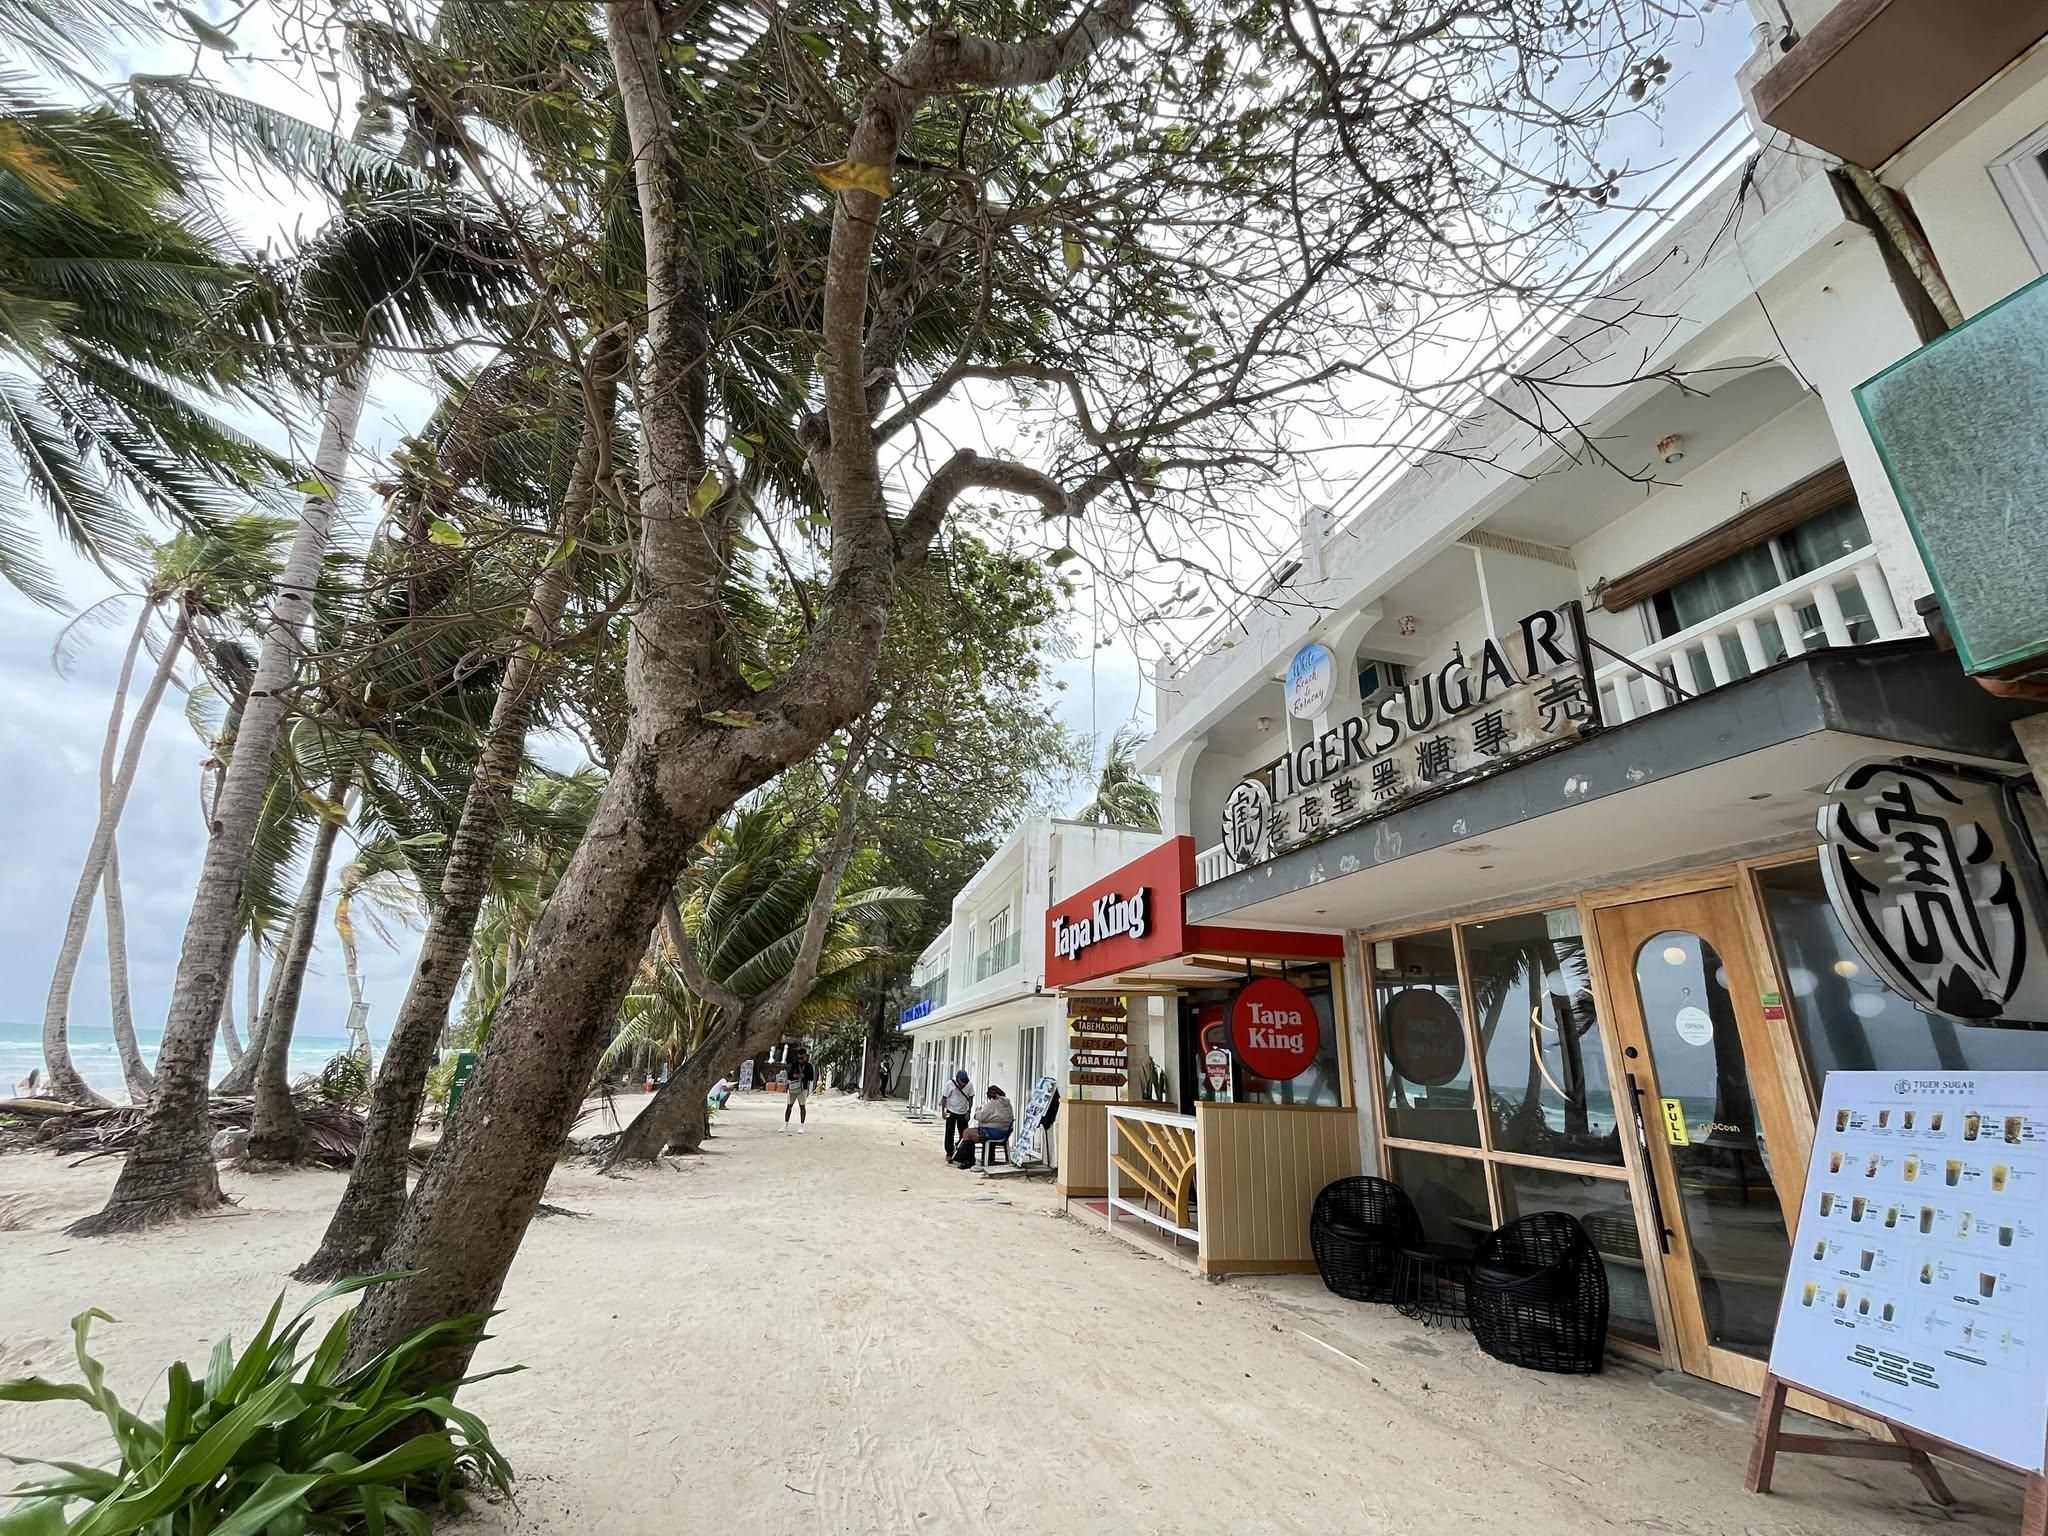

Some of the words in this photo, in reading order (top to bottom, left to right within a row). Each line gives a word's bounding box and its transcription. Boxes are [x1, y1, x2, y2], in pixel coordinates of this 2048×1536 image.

[1293, 650, 1316, 677] White
[1295, 668, 1319, 694] Beach
[1294, 689, 1325, 715] Boracay
[1052, 915, 1091, 961] Tapa
[1092, 886, 1145, 943] King
[1078, 1021, 1124, 1033] TABEMASHOU
[1246, 1001, 1302, 1030] Tapa
[1248, 1027, 1304, 1054] King
[1076, 1055, 1100, 1066] TARA
[1102, 1056, 1125, 1067] KAIN
[1913, 1080, 1940, 1089] TIGER
[1942, 1080, 1975, 1090] SUGAR
[1666, 1103, 1682, 1142] PULL
